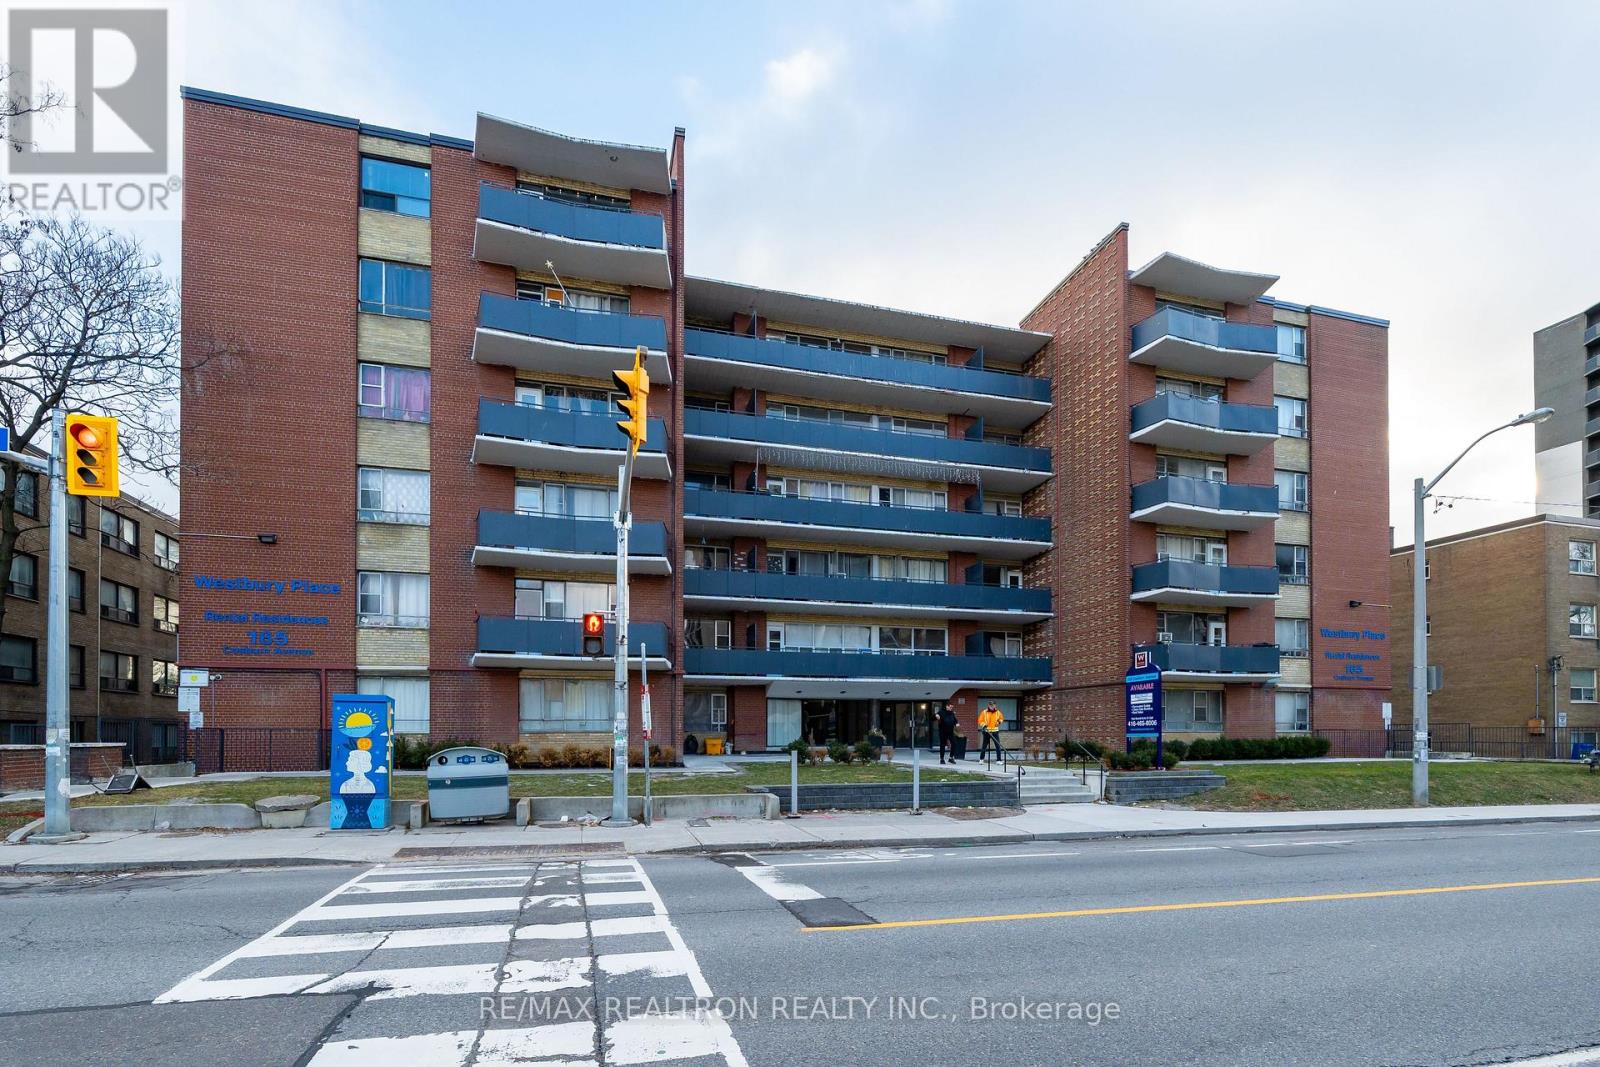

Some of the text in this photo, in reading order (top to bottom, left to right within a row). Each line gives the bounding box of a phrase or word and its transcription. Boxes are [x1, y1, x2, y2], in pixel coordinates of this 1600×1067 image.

[194, 575, 342, 596] Westbury Place
[1130, 683, 1154, 691] AVAILABLE
